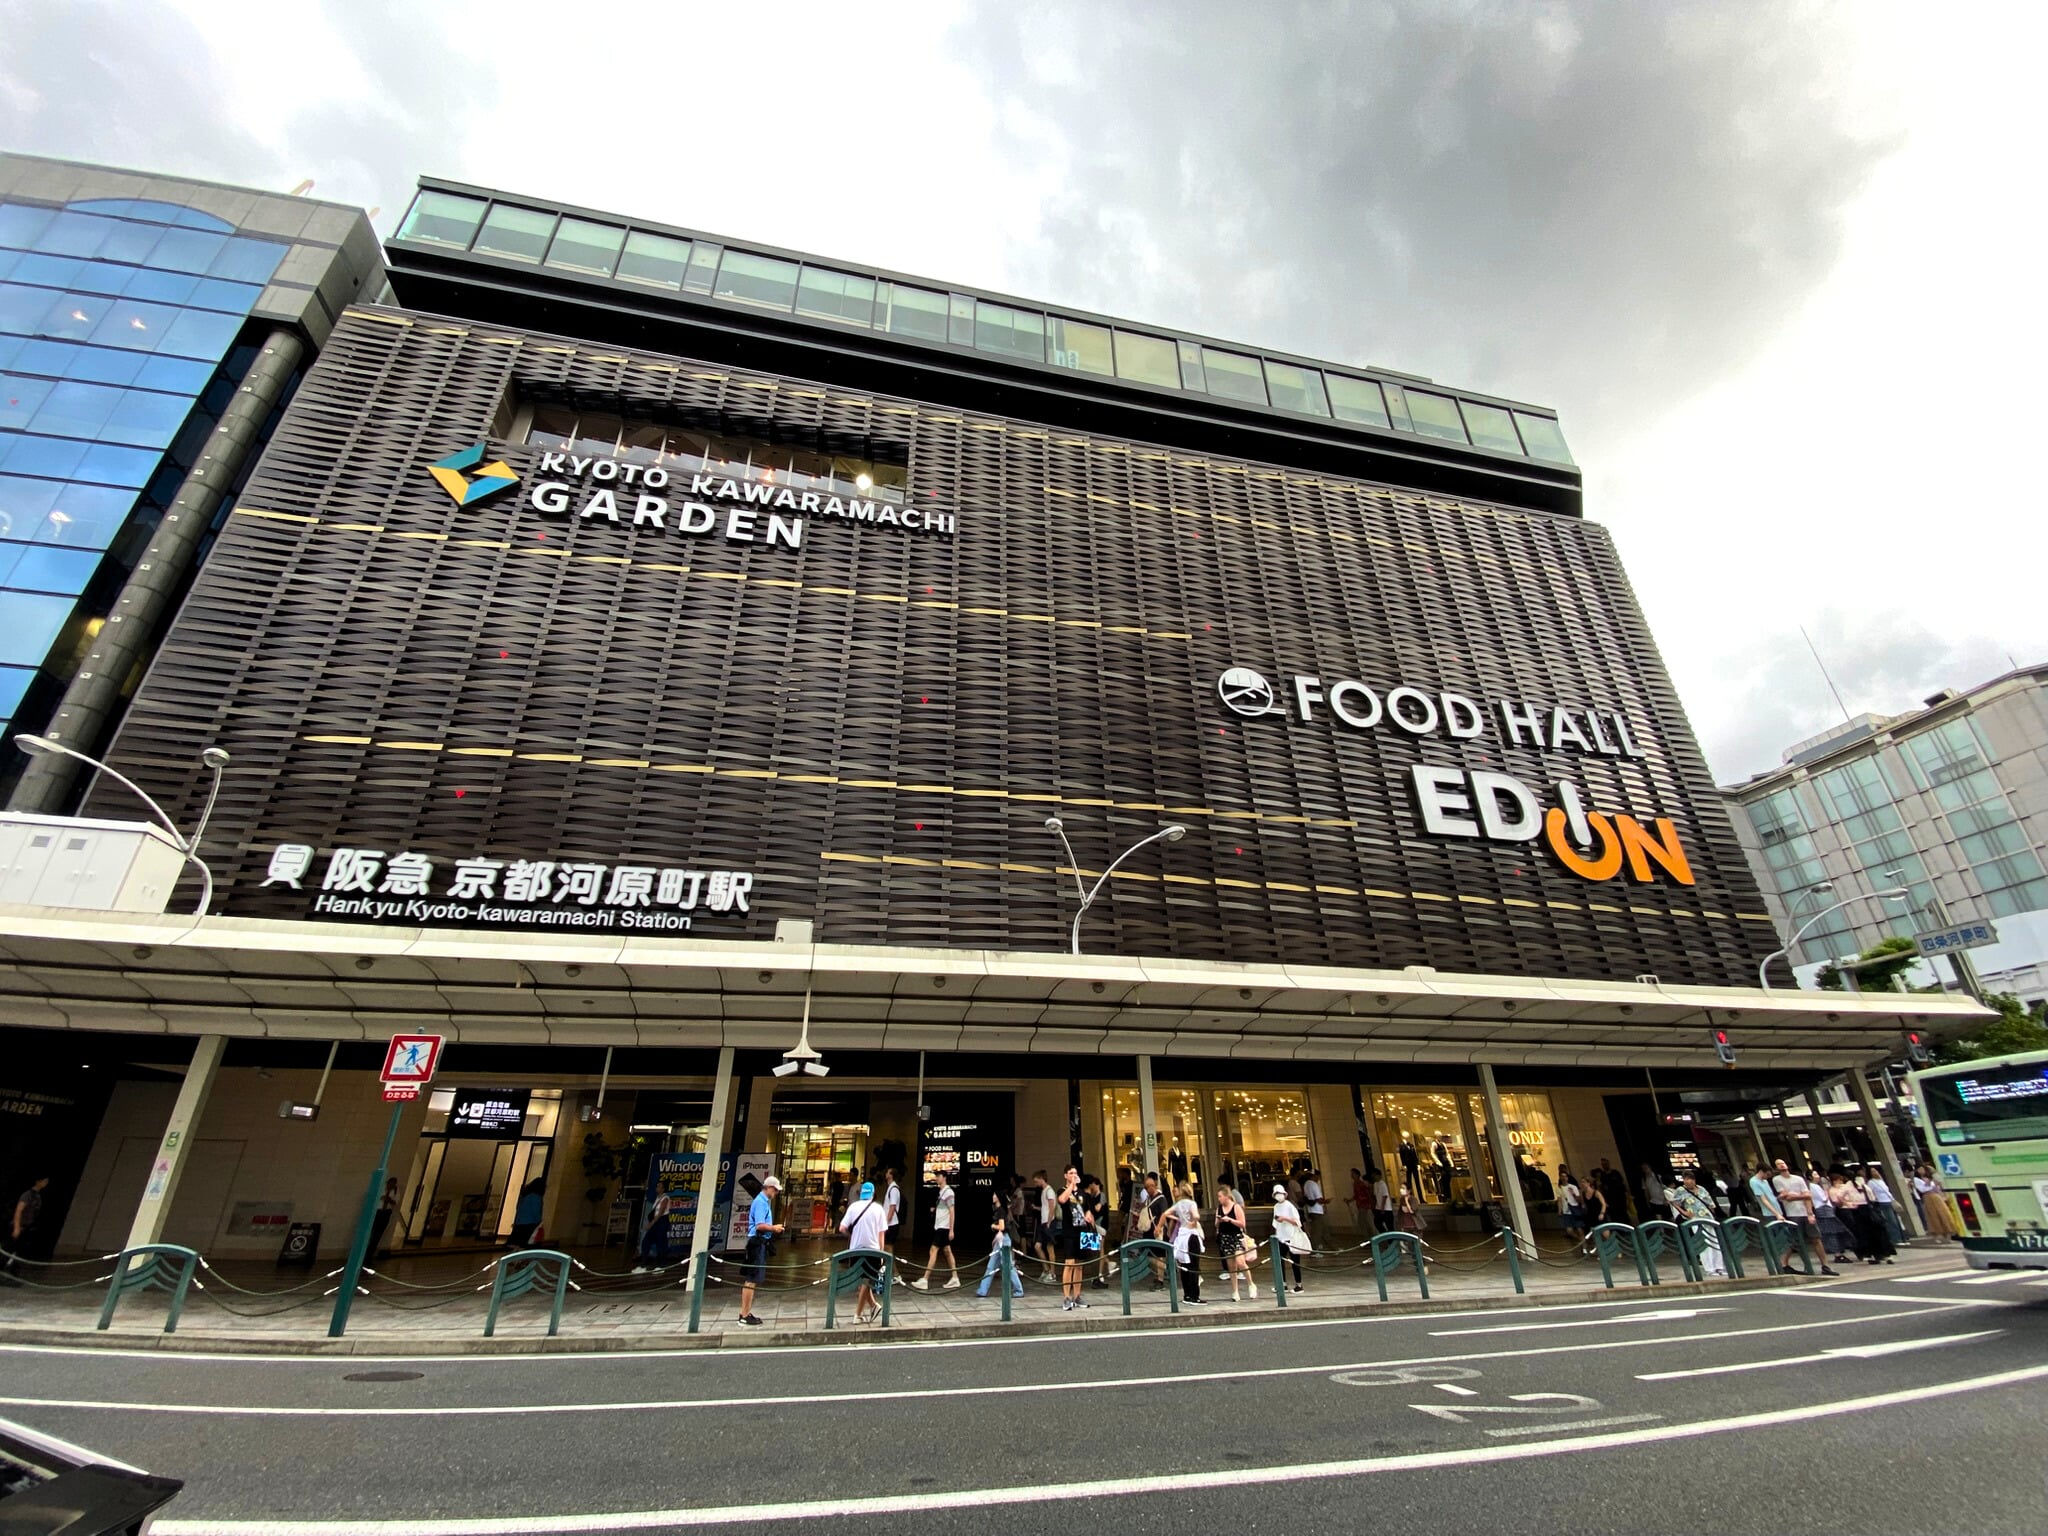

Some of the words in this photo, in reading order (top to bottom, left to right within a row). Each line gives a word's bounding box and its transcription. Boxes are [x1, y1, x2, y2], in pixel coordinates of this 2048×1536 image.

[541, 451, 669, 489] KYOTO
[691, 474, 955, 534] KAWARAMACHI
[531, 482, 804, 549] GARDEN
[1294, 675, 1484, 739] FOOD
[1500, 700, 1647, 758] HALL
[1411, 764, 1696, 886] EDION
[322, 847, 434, 897] 阪急
[447, 856, 754, 913] 京都河原町駅
[315, 895, 401, 918] Hankyu
[405, 898, 616, 928] Kyoto-kawaramachi
[619, 909, 692, 930] Station
[1921, 926, 1989, 951] 四条河原町
[0, 1100, 44, 1115] ARDEN
[933, 1130, 961, 1138] GARDEN
[1508, 1130, 1545, 1146] ONLY
[742, 1161, 769, 1170] iPhone
[967, 1150, 999, 1167] EDION
